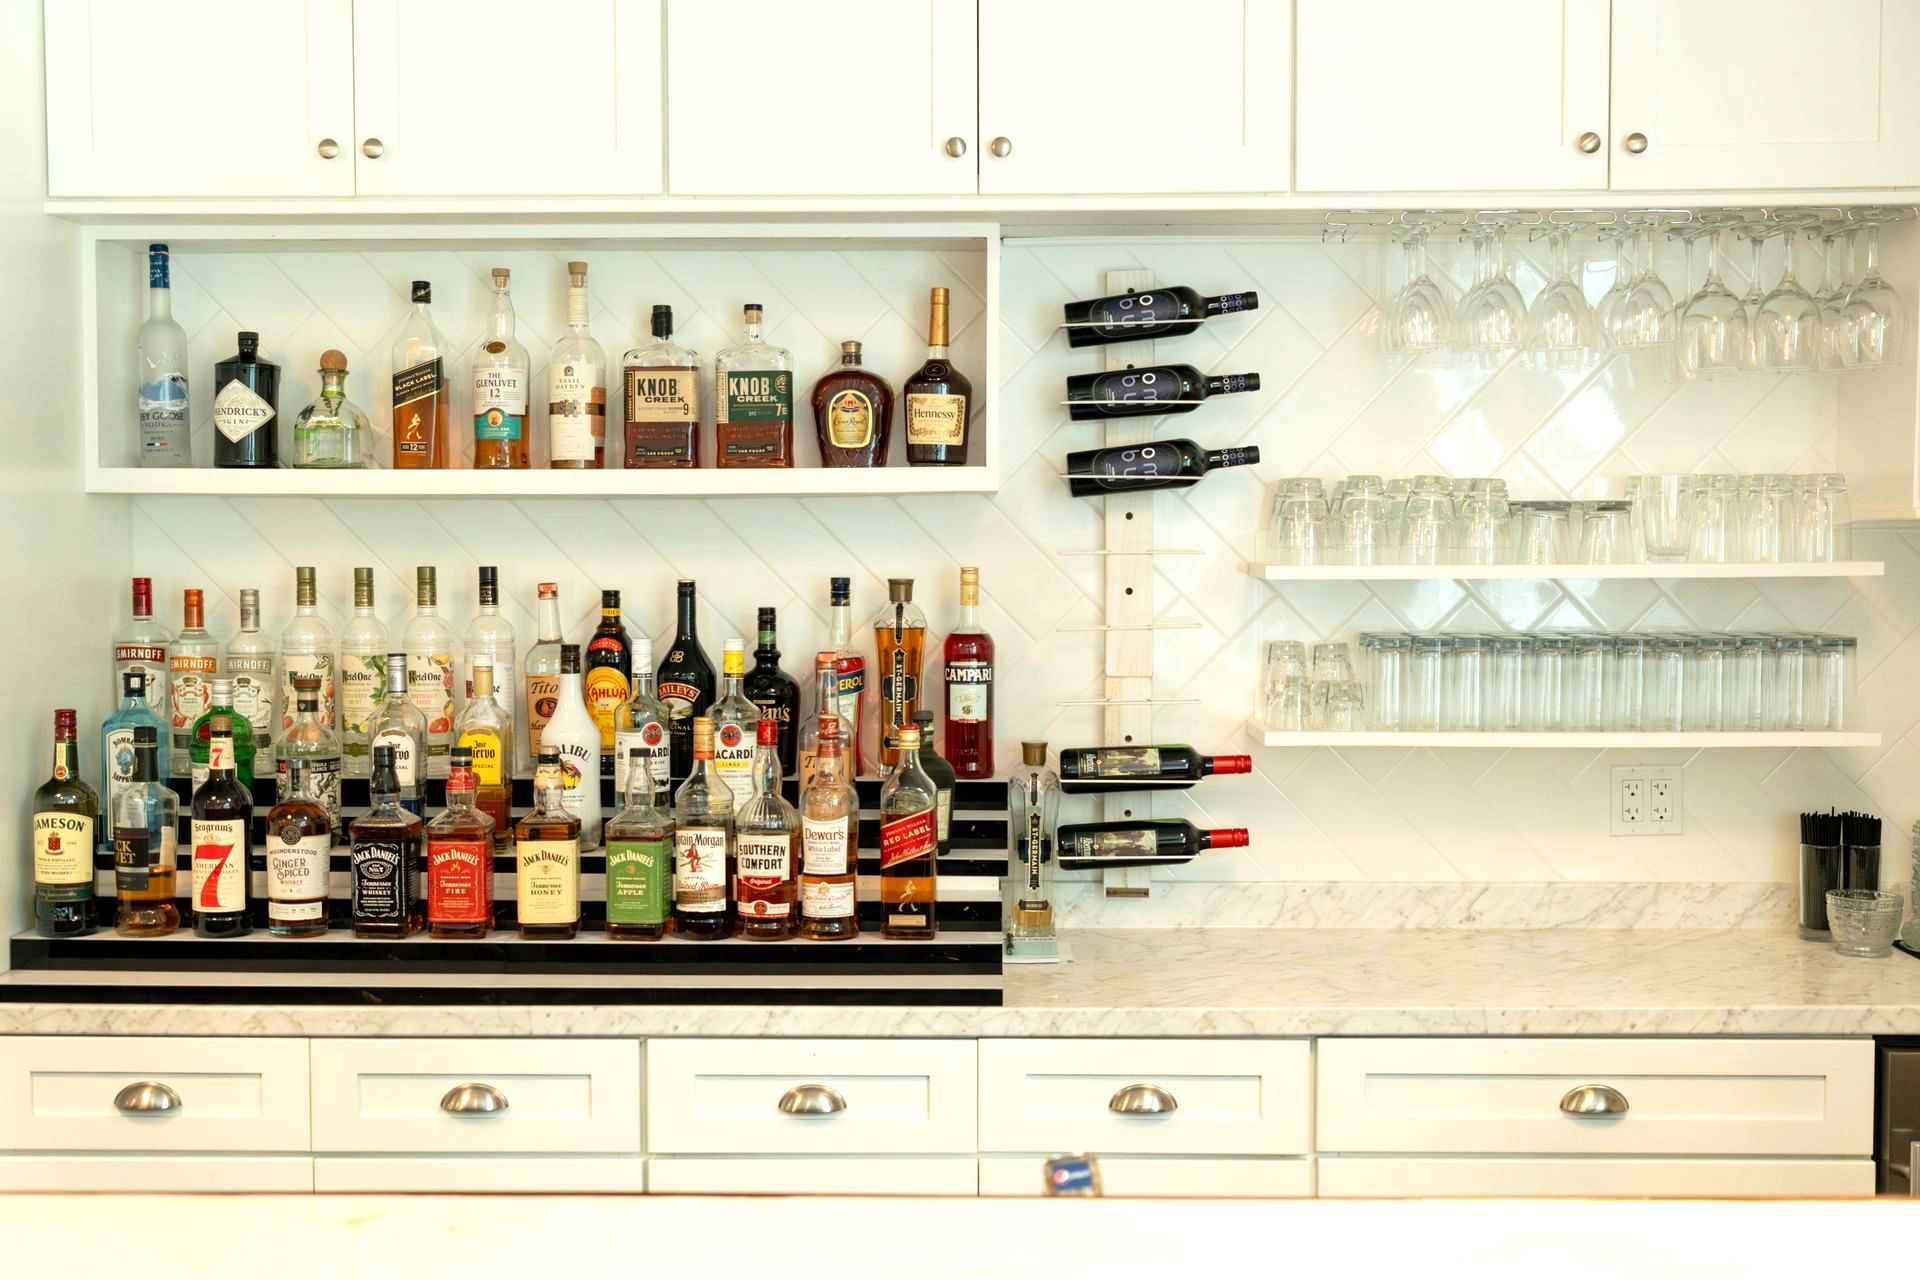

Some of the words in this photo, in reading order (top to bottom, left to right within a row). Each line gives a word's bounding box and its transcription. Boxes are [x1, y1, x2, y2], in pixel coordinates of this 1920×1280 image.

[394, 379, 415, 391] BLACK
[415, 372, 436, 383] LABEL
[476, 379, 518, 389] GLENLIVET
[637, 378, 678, 396] KNOB
[729, 377, 770, 396] KNOB
[489, 388, 501, 398] 12
[683, 403, 689, 416] 9
[775, 403, 782, 417] 7
[914, 407, 956, 420] Hennessy
[409, 443, 418, 451] 12
[116, 648, 163, 660] SMIRNOFF
[170, 658, 214, 670] SMIRNOFF
[357, 672, 372, 681] One
[408, 670, 426, 683] Ketel
[427, 671, 442, 681] One
[945, 667, 992, 682] CAMPARI
[531, 680, 559, 694] Tito
[586, 682, 628, 703] KAHLÚA
[659, 684, 697, 699] BAILEYS
[474, 740, 486, 750] Jose
[211, 748, 223, 767] 7
[472, 749, 496, 759] uervo
[715, 746, 753, 760] ACARDÍ
[34, 817, 85, 833] JAMESON
[194, 823, 234, 834] Seagram's
[694, 833, 724, 848] Morgan
[804, 827, 845, 841] Dewar's
[883, 837, 901, 847] RED
[903, 824, 932, 838] LABEL
[739, 844, 786, 857] SOUTHERN
[807, 844, 823, 852] White
[824, 844, 841, 853] Label
[353, 849, 371, 865] JACK
[370, 846, 401, 865] DANIEL'S
[433, 851, 452, 866] JACK
[451, 848, 480, 866] DANIEL'S
[523, 853, 541, 867] JACK
[541, 849, 569, 867] DANIEL'S
[609, 852, 627, 867] JACK
[626, 849, 655, 868] DANIEL'S
[272, 857, 307, 870] GINGER
[741, 857, 783, 870] COMFORT
[194, 842, 236, 908] 7
[277, 867, 311, 880] SPICED
[361, 878, 392, 887] Tennessee
[440, 880, 472, 888] Tennessee
[530, 881, 562, 889] Tennessee
[616, 881, 647, 889] Tennessee
